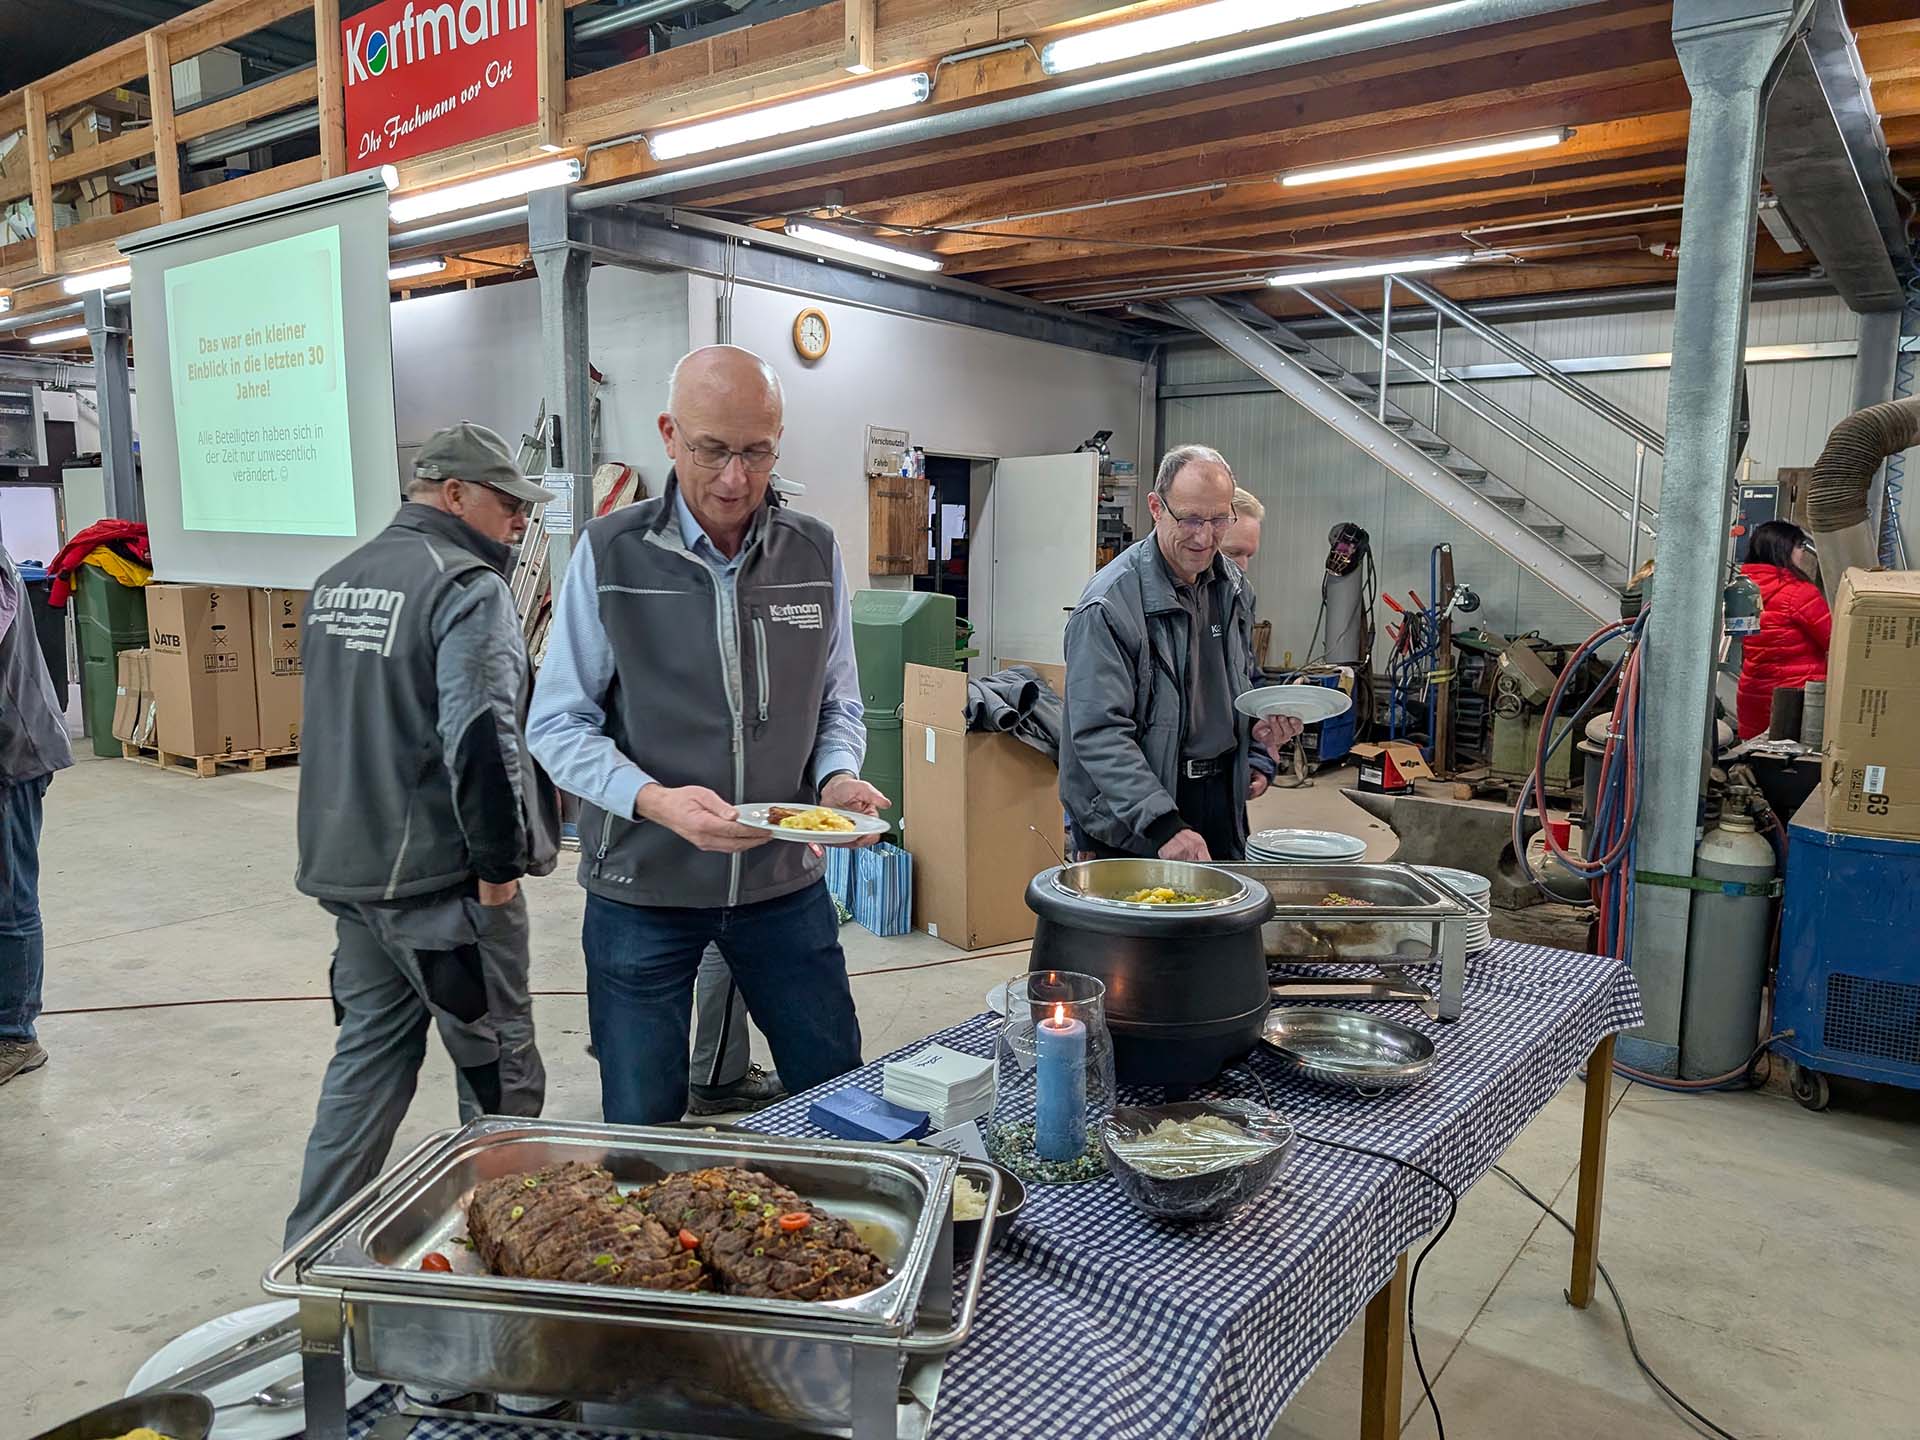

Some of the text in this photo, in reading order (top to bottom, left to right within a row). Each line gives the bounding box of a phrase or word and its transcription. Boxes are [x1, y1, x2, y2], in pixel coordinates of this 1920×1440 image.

[384, 96, 456, 149] Fachmann
[460, 81, 481, 105] vor
[485, 60, 513, 88] Ort
[199, 323, 306, 354] Das war ein kleiner
[188, 345, 324, 381] Einblick in die letzten 30
[236, 380, 271, 401] Jahre!
[198, 423, 324, 446] Alle Beteiligten haben sich in
[205, 445, 317, 464] der Zeit nur unwesentlich
[232, 467, 277, 482] verändert.
[1867, 793, 1890, 816] 63
